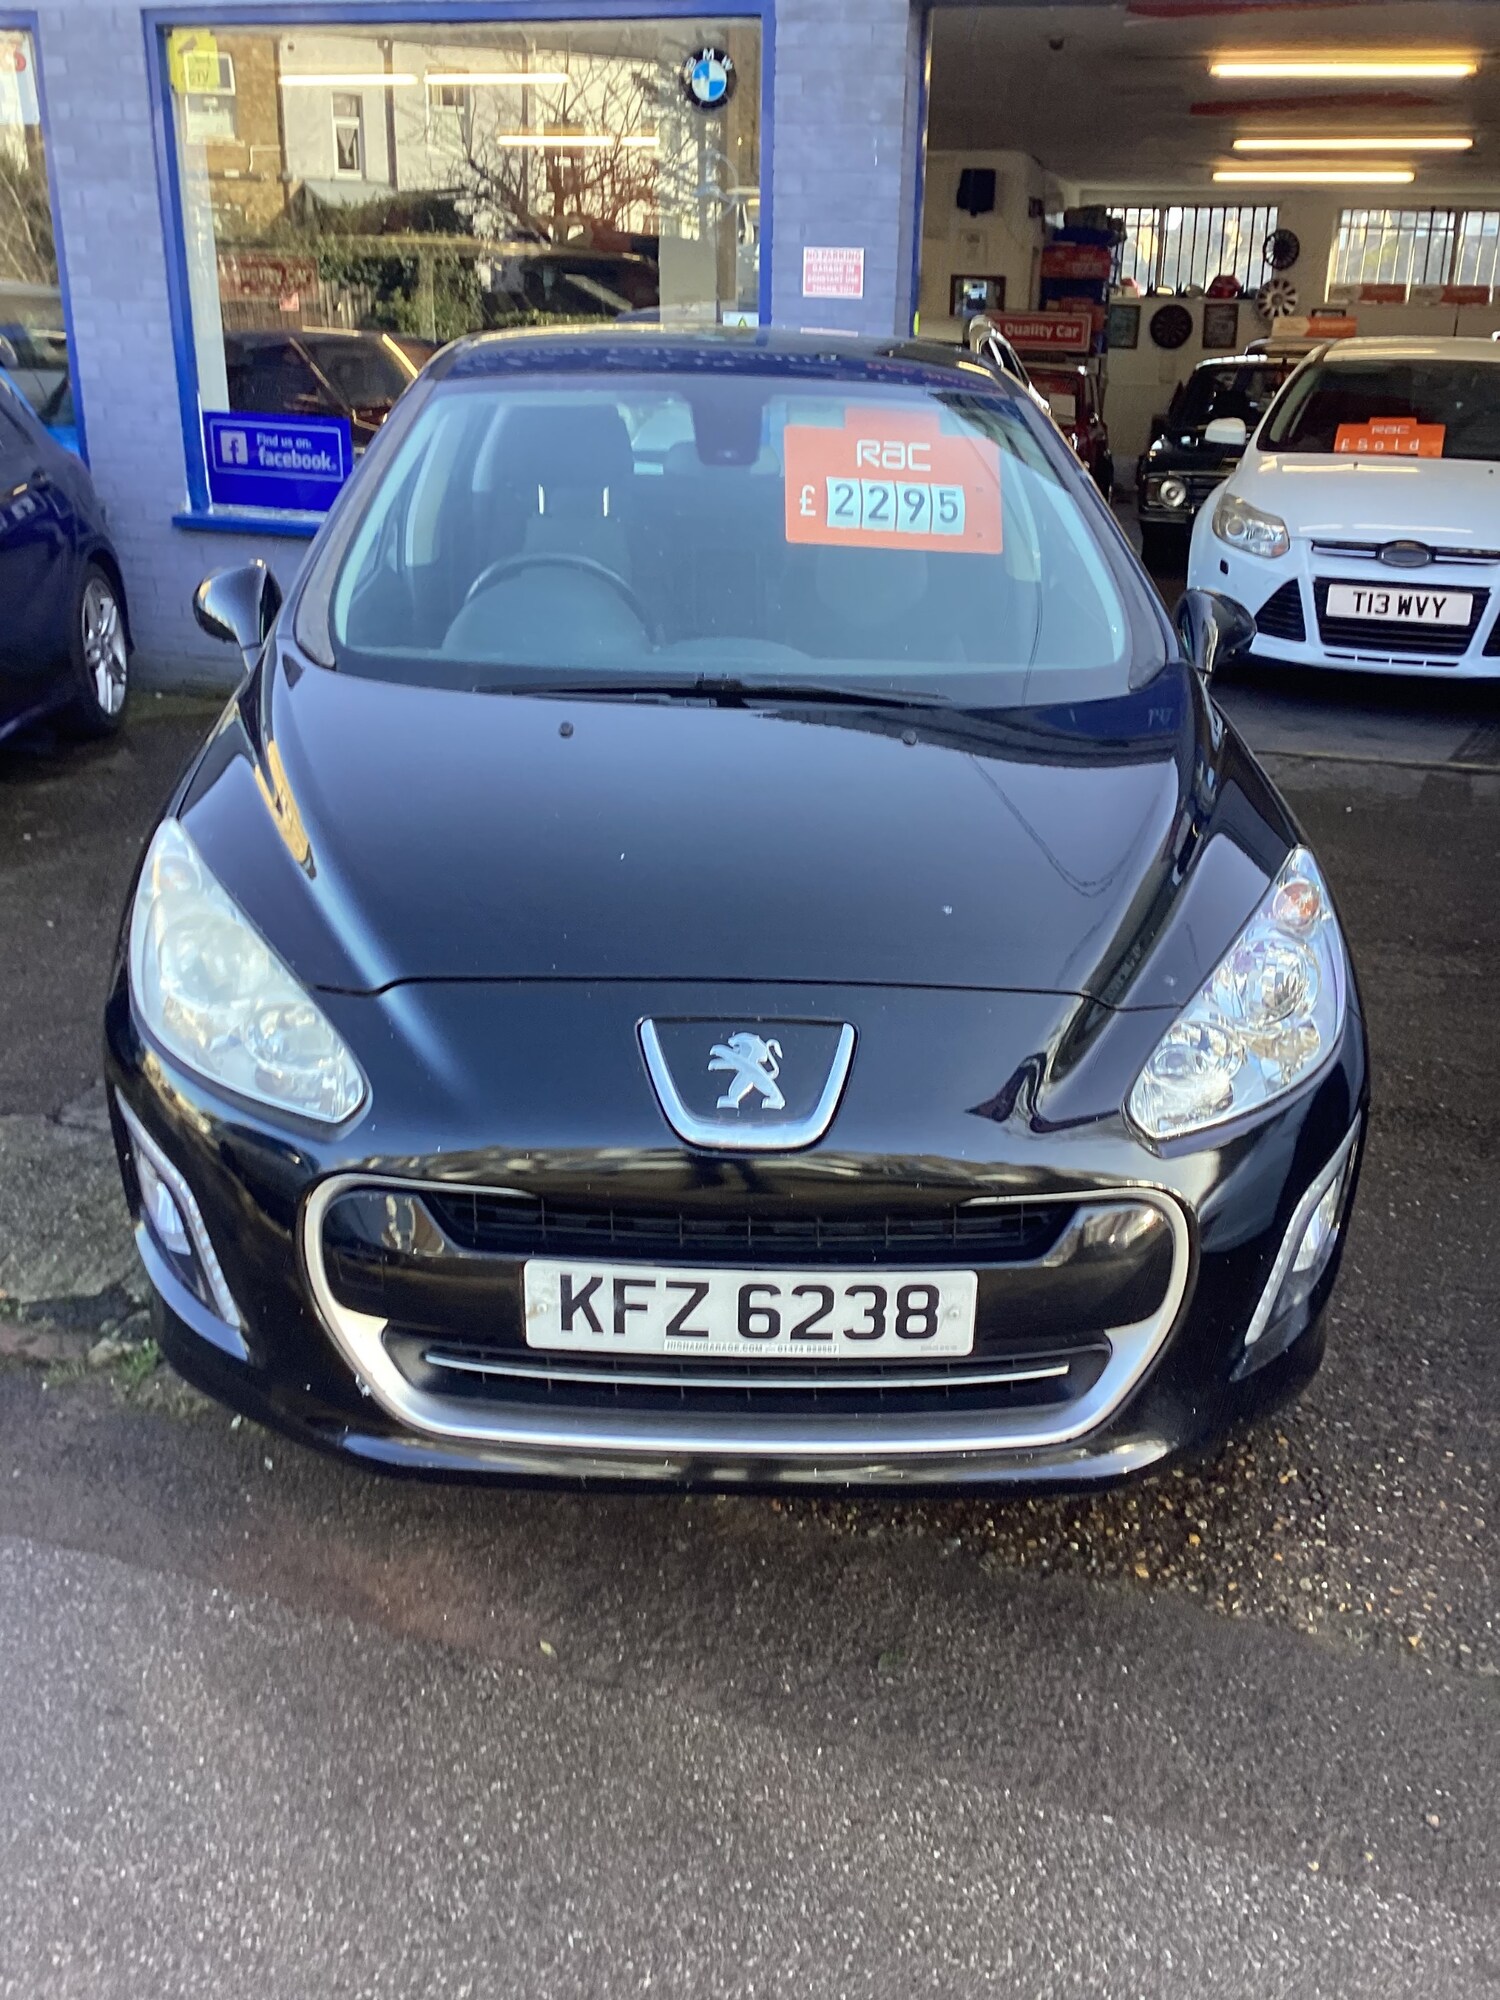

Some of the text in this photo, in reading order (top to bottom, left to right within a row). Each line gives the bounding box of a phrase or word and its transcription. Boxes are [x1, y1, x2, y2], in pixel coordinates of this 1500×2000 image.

[685, 48, 734, 71] BMW
[806, 249, 861, 260] NO PARKING
[846, 265, 855, 273] IN
[1004, 322, 1054, 339] Quality
[1056, 325, 1080, 339] Car
[256, 432, 279, 447] Find
[281, 436, 293, 447] us
[1353, 591, 1447, 619] T13 WVY
[559, 1274, 940, 1341] KFZ 6238
